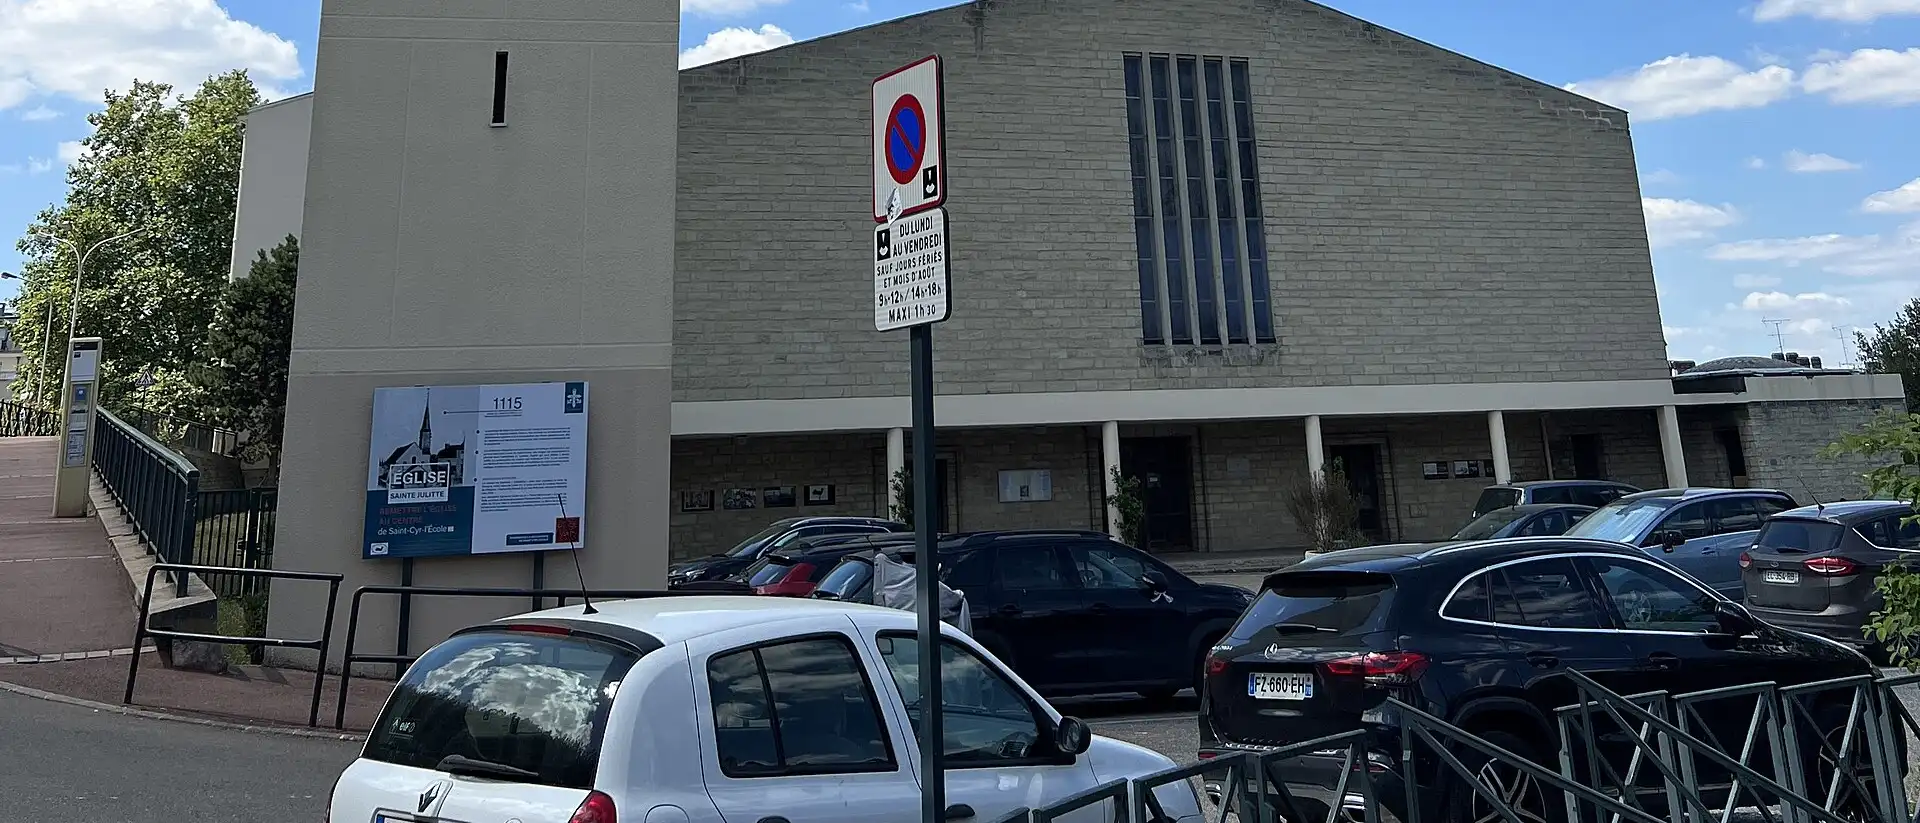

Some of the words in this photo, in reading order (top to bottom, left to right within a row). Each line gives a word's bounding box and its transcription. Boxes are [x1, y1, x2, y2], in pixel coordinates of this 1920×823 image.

[899, 224, 909, 238] DU
[910, 216, 933, 235] LUNDI
[893, 244, 903, 258] AU
[903, 233, 942, 255] VENDREDI
[877, 263, 893, 276] SAUF
[895, 257, 916, 272] JOURS
[918, 251, 942, 267] FÉRIÉS
[883, 277, 892, 288] ET
[893, 272, 910, 286] MOIS
[911, 267, 935, 282] D'AOÛT
[888, 306, 911, 323] MAXI
[493, 396, 522, 410] 1115
[377, 528, 388, 536] de
